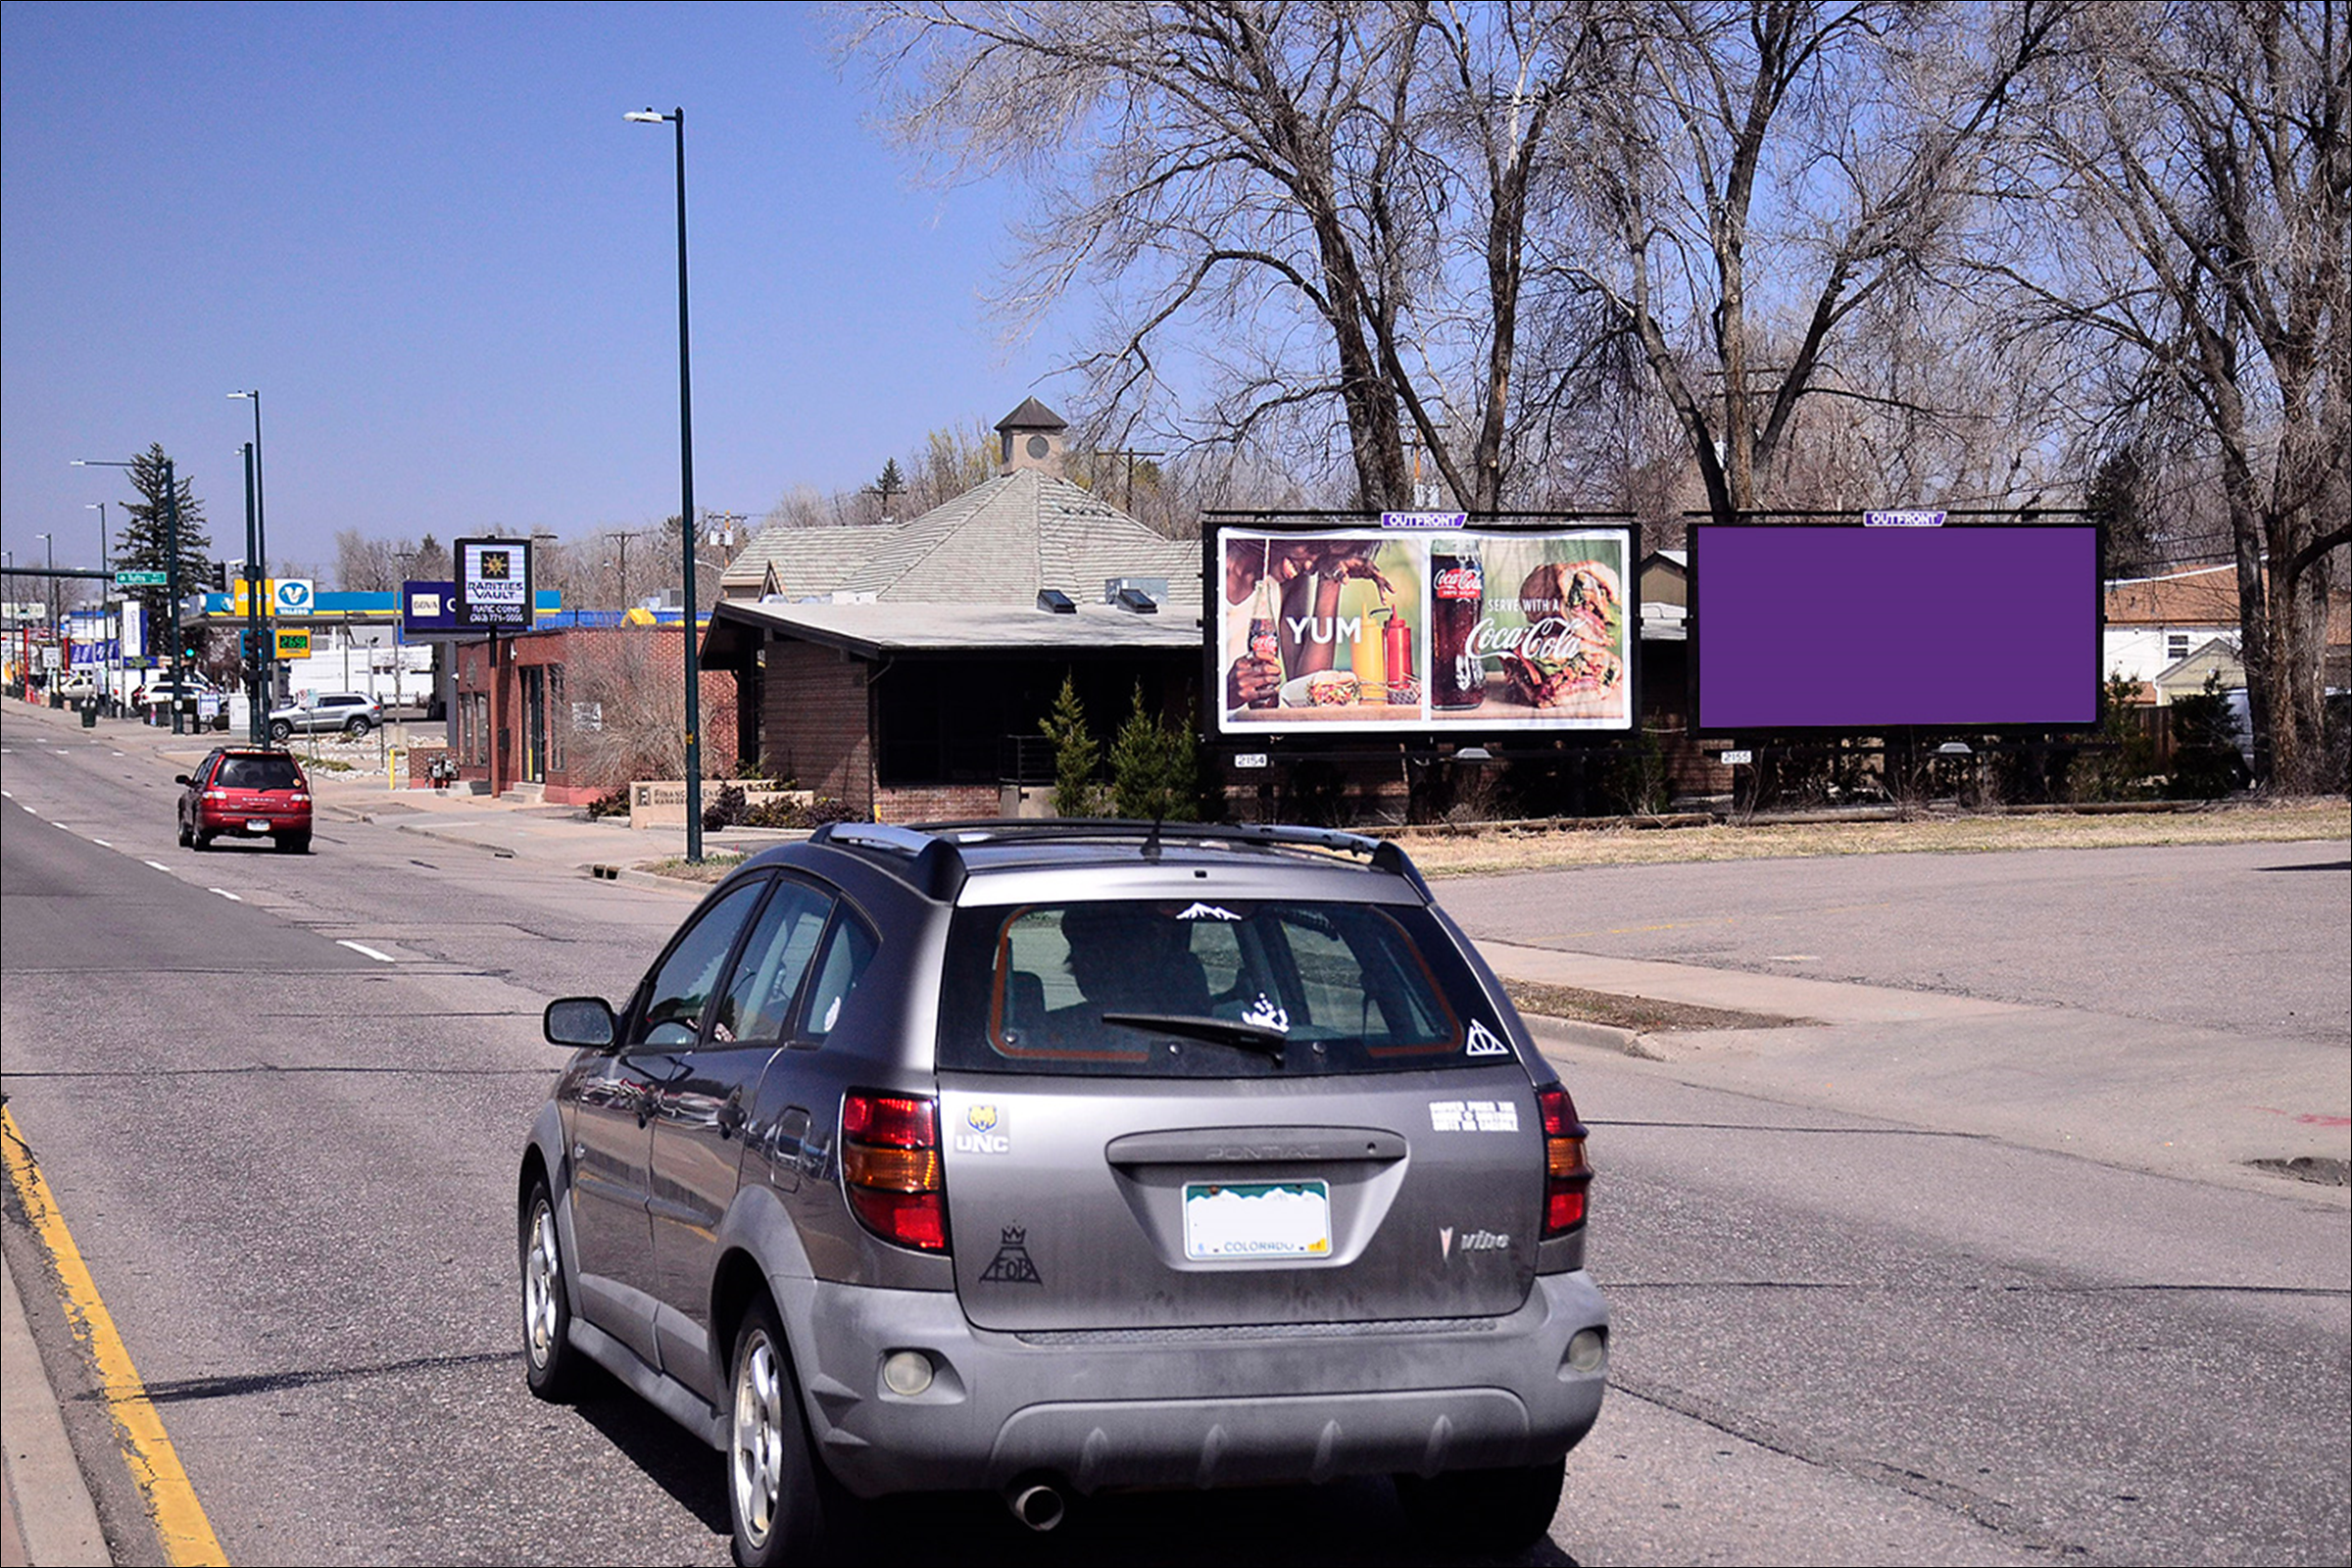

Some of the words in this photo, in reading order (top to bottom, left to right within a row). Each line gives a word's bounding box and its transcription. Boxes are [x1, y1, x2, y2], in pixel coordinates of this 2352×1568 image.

[1389, 514, 1459, 527] OUTFRONT
[1871, 513, 1938, 526] OUTFRONT
[468, 582, 524, 591] RARITIES
[474, 590, 515, 599] VAULT
[1488, 599, 1519, 612] SERVE
[1522, 599, 1549, 612] WITH
[1552, 598, 1560, 612] A
[1286, 616, 1361, 644] YUM
[1465, 616, 1588, 660] Coca-Cola
[1237, 755, 1265, 765] 2154
[1723, 752, 1750, 762] 2155
[655, 789, 686, 798] FINANC
[956, 1133, 1009, 1153] UNC
[1205, 1144, 1321, 1160] PONTIAC
[1461, 1229, 1510, 1250] vibe
[1224, 1241, 1295, 1252] COLORADO
[994, 1256, 1031, 1282] FOB
